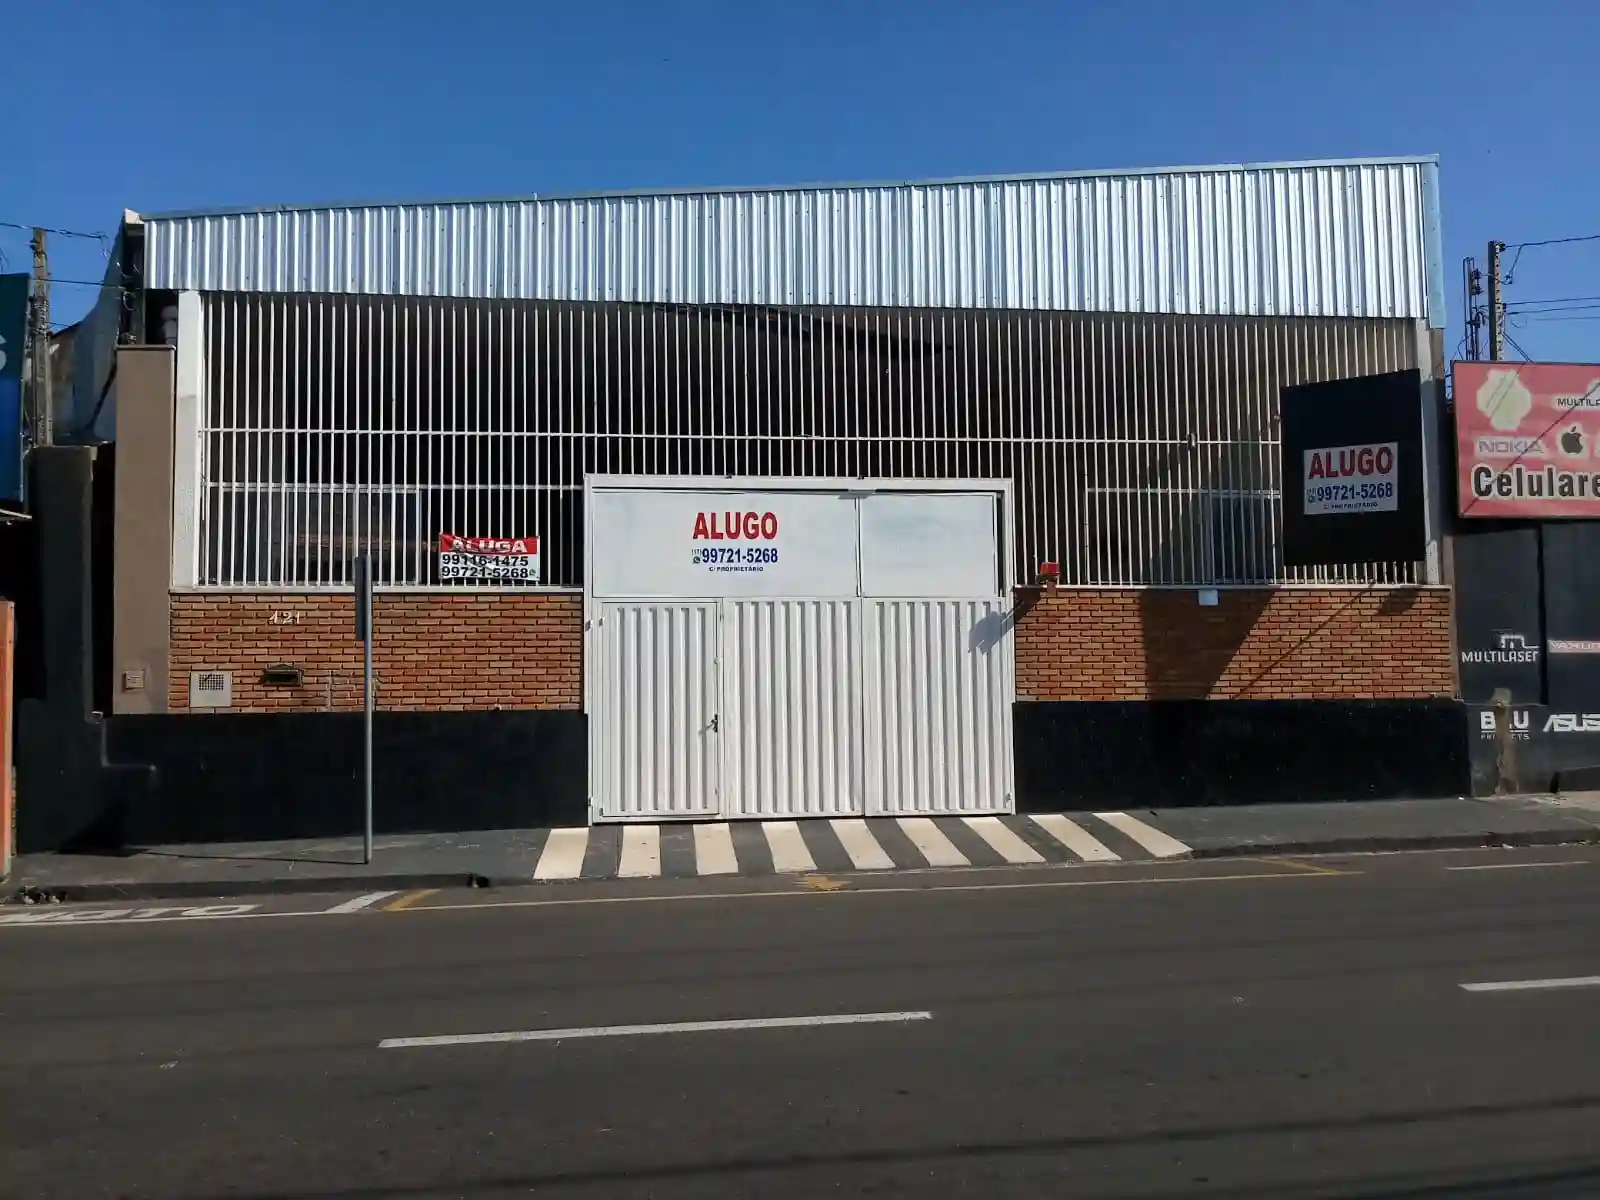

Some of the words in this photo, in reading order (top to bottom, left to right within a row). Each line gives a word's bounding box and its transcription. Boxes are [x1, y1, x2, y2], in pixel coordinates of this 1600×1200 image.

[1479, 440, 1544, 453] NOKIA
[1308, 446, 1393, 479] ALUGO
[1317, 482, 1393, 502] 99721-5268
[692, 511, 778, 540] ALUGO
[450, 539, 528, 553] ALUGA
[702, 548, 778, 563] 99721-5268
[441, 566, 528, 579] 99721-5268
[1480, 710, 1529, 730] BU
